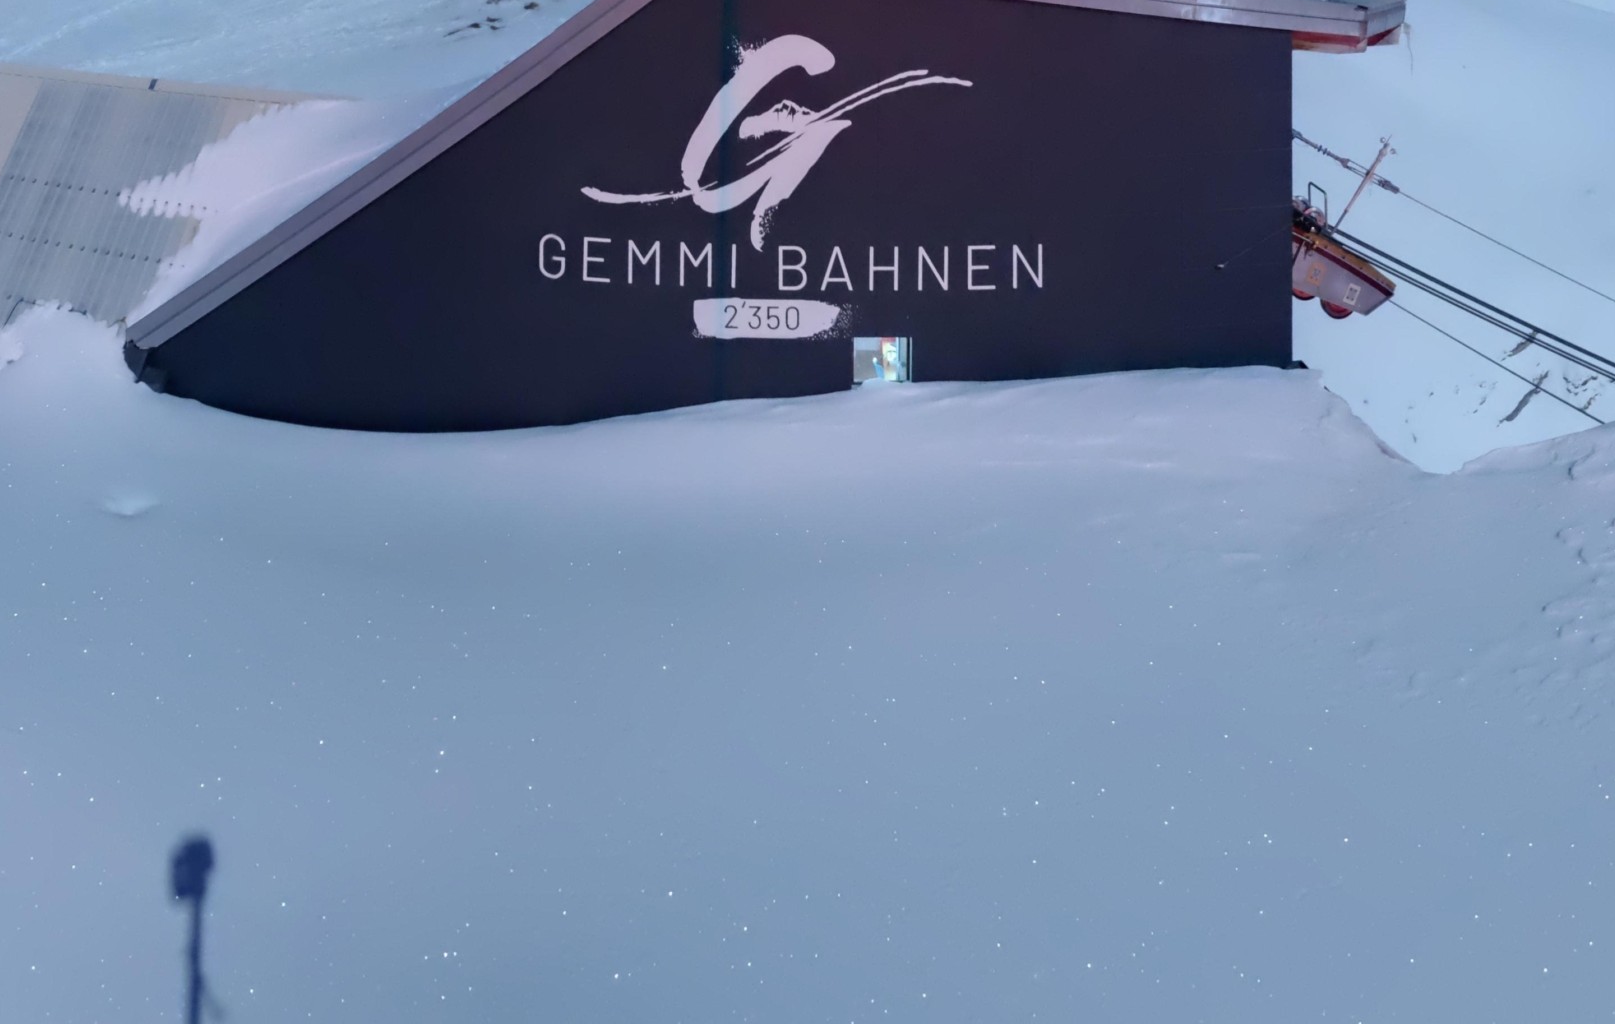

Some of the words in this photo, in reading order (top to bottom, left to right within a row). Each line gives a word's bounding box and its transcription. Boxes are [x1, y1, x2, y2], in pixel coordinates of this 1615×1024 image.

[539, 234, 737, 287] GEMMI
[778, 243, 1044, 292] BAHNEN
[723, 301, 801, 331] 2'350
